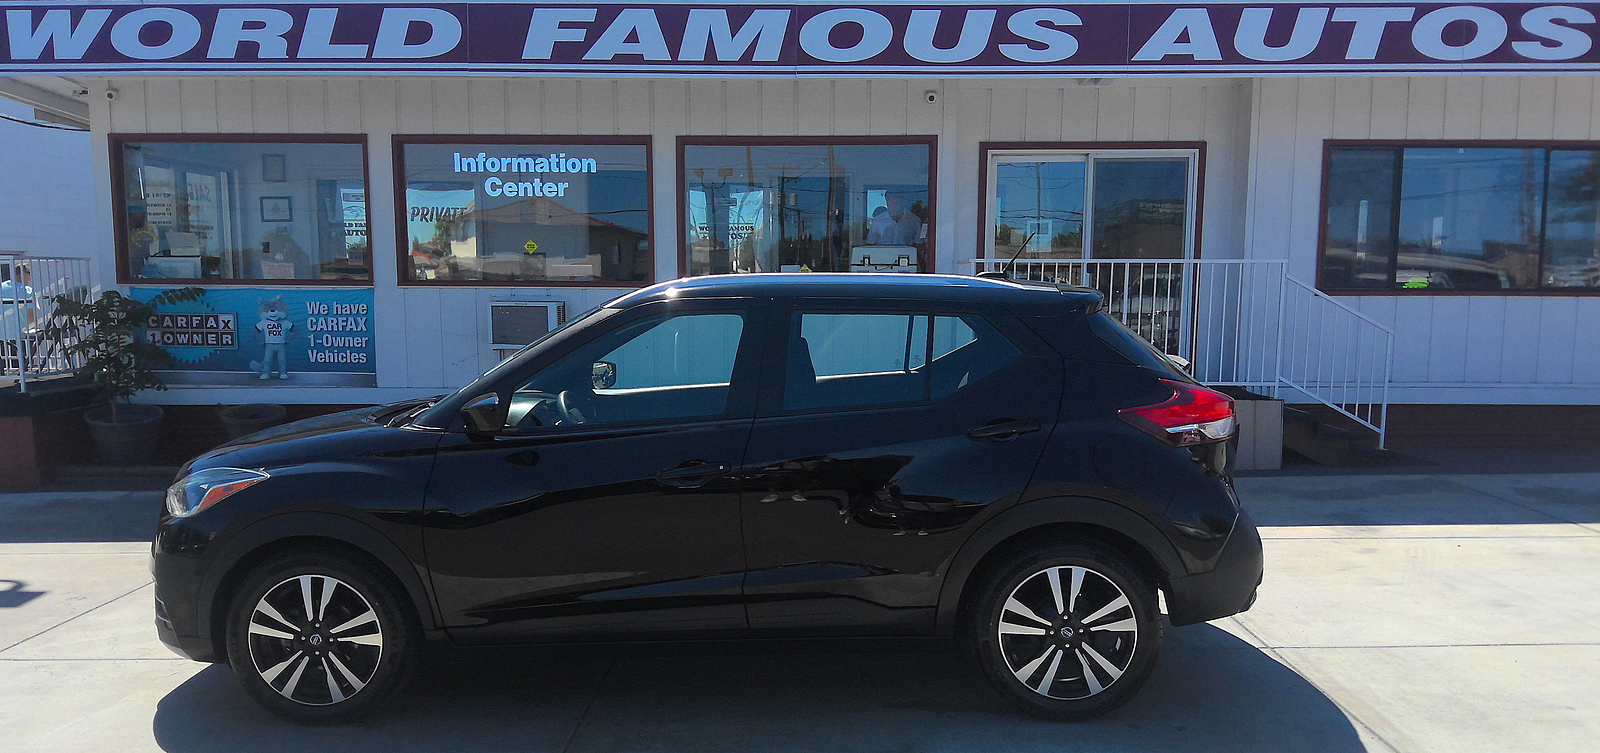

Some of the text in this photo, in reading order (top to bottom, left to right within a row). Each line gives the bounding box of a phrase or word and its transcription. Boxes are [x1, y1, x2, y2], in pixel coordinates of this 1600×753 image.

[5, 5, 1597, 63] WORLD FAMOUS AUTOS
[453, 152, 597, 173] Information
[484, 177, 569, 197] Center
[306, 301, 368, 315] We have
[148, 316, 232, 330] CARFAX
[307, 317, 368, 332] CARFAX
[163, 333, 232, 345] OWNER
[308, 334, 369, 348] 1-Owner
[307, 349, 368, 364] Vehicles
